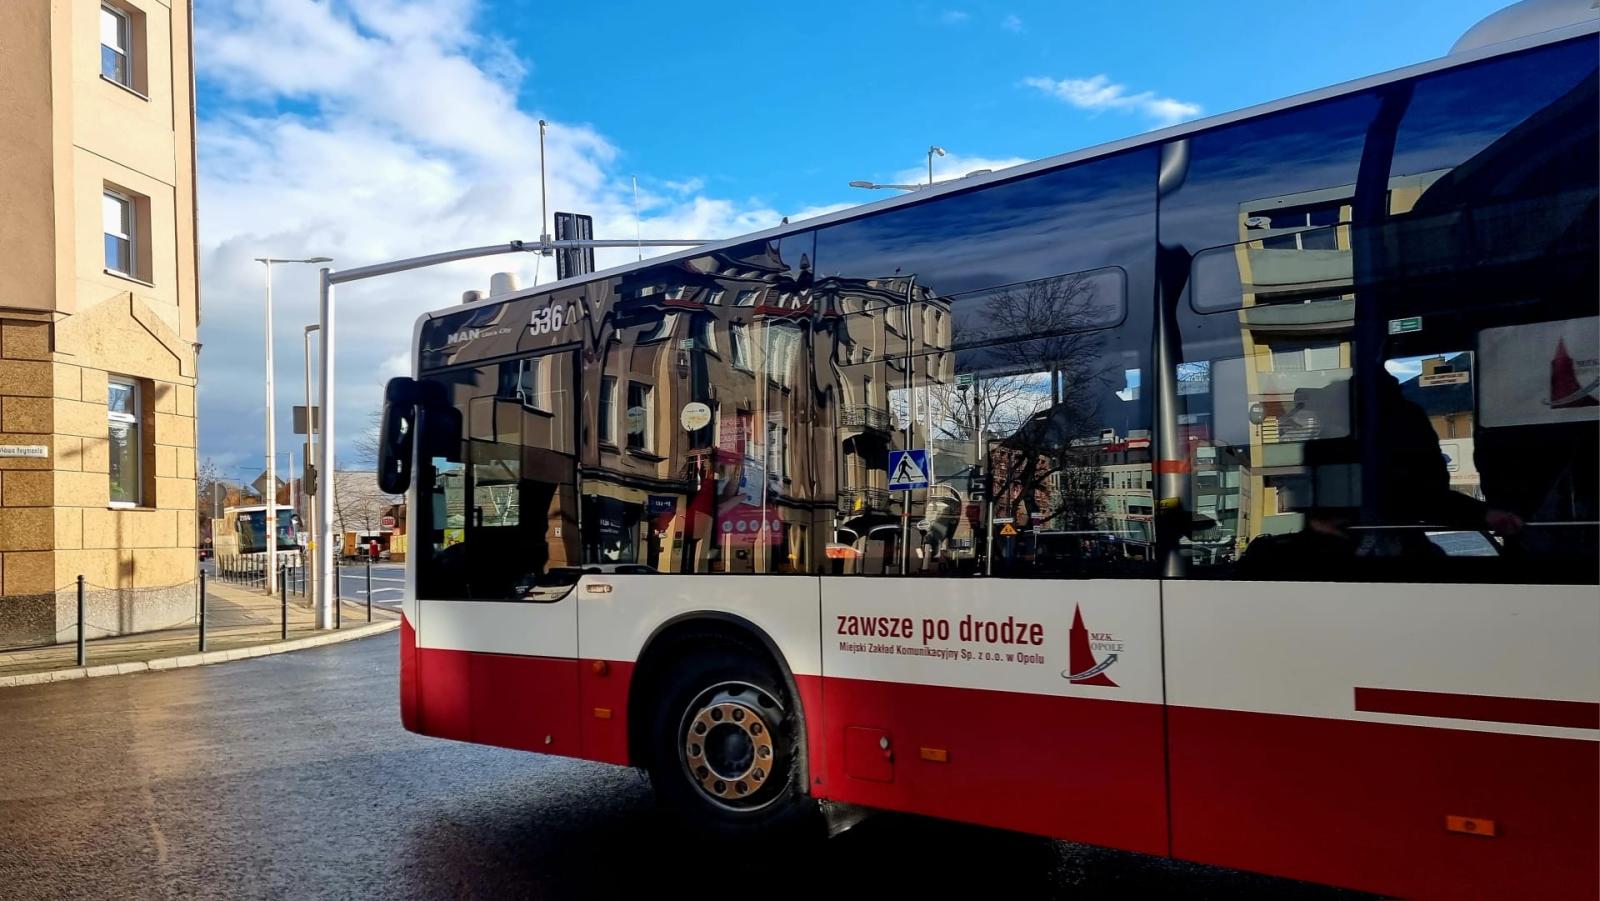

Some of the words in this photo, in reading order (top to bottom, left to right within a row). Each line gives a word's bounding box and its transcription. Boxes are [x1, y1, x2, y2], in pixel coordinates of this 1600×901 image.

[530, 305, 562, 336] 536
[447, 329, 480, 344] MAN
[837, 615, 913, 638] zawsze
[923, 618, 949, 645] po
[959, 614, 1044, 645] drodze
[1091, 633, 1112, 641] MZK
[839, 641, 866, 653] Miejski
[868, 643, 894, 654] Zakład
[896, 645, 959, 660] Komunikacyjny
[960, 648, 976, 661] Sp.
[978, 652, 983, 660] z
[1006, 654, 1014, 662] w
[1016, 652, 1045, 665] Opolu
[1091, 642, 1124, 652] OPOLE
